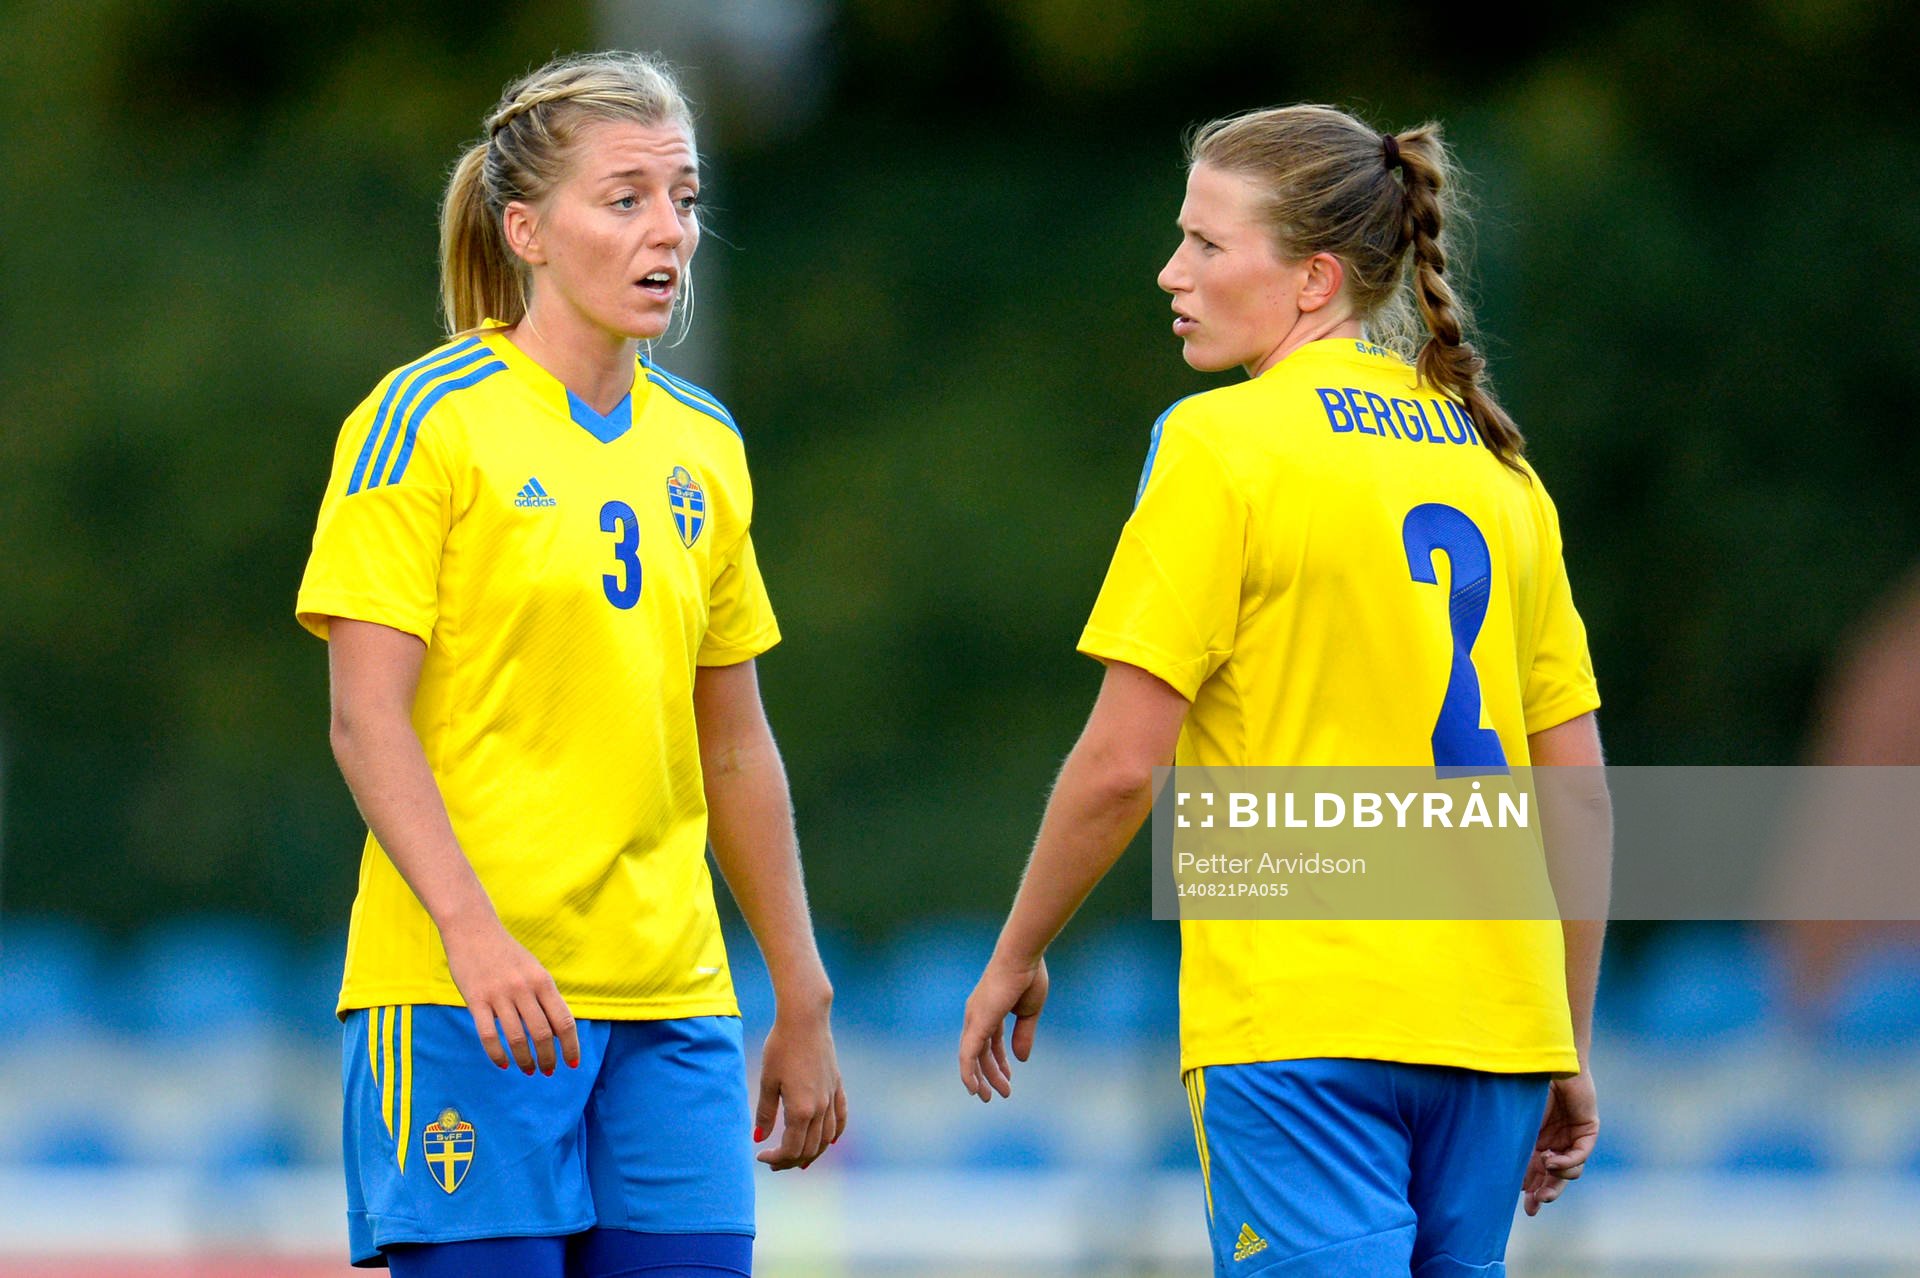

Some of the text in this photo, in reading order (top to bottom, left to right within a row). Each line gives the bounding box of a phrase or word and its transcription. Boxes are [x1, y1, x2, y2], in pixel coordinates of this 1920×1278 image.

[514, 496, 557, 507] adidas
[599, 500, 642, 610] 3
[1402, 502, 1511, 780] 2
[436, 1133, 463, 1141] SvFF
[1233, 1239, 1267, 1262] adidas
